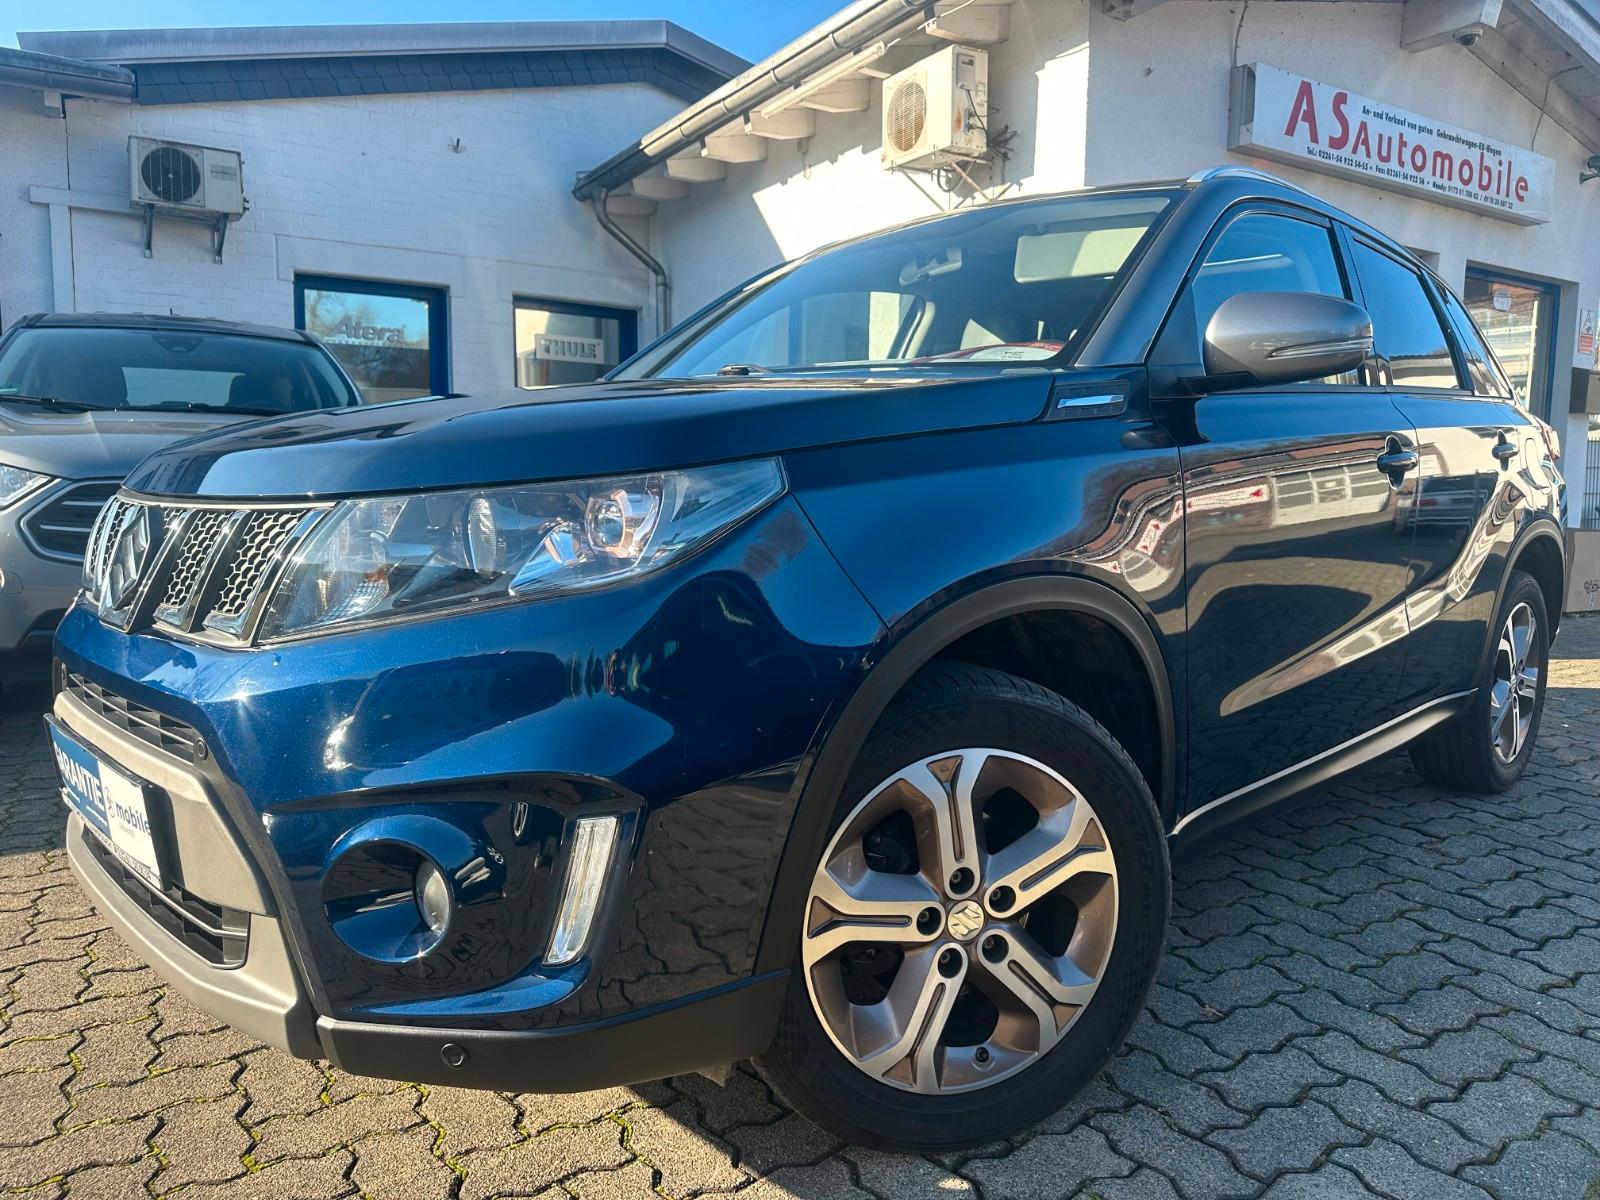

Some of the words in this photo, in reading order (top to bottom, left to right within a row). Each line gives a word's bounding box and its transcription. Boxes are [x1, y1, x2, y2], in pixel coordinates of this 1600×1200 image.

[1373, 110, 1384, 120] und
[1385, 112, 1407, 127] Verkauf
[1407, 121, 1417, 130] von
[1418, 124, 1434, 135] guten
[329, 315, 405, 343] Atera
[542, 339, 597, 359] THULE
[115, 802, 152, 837] mobile
